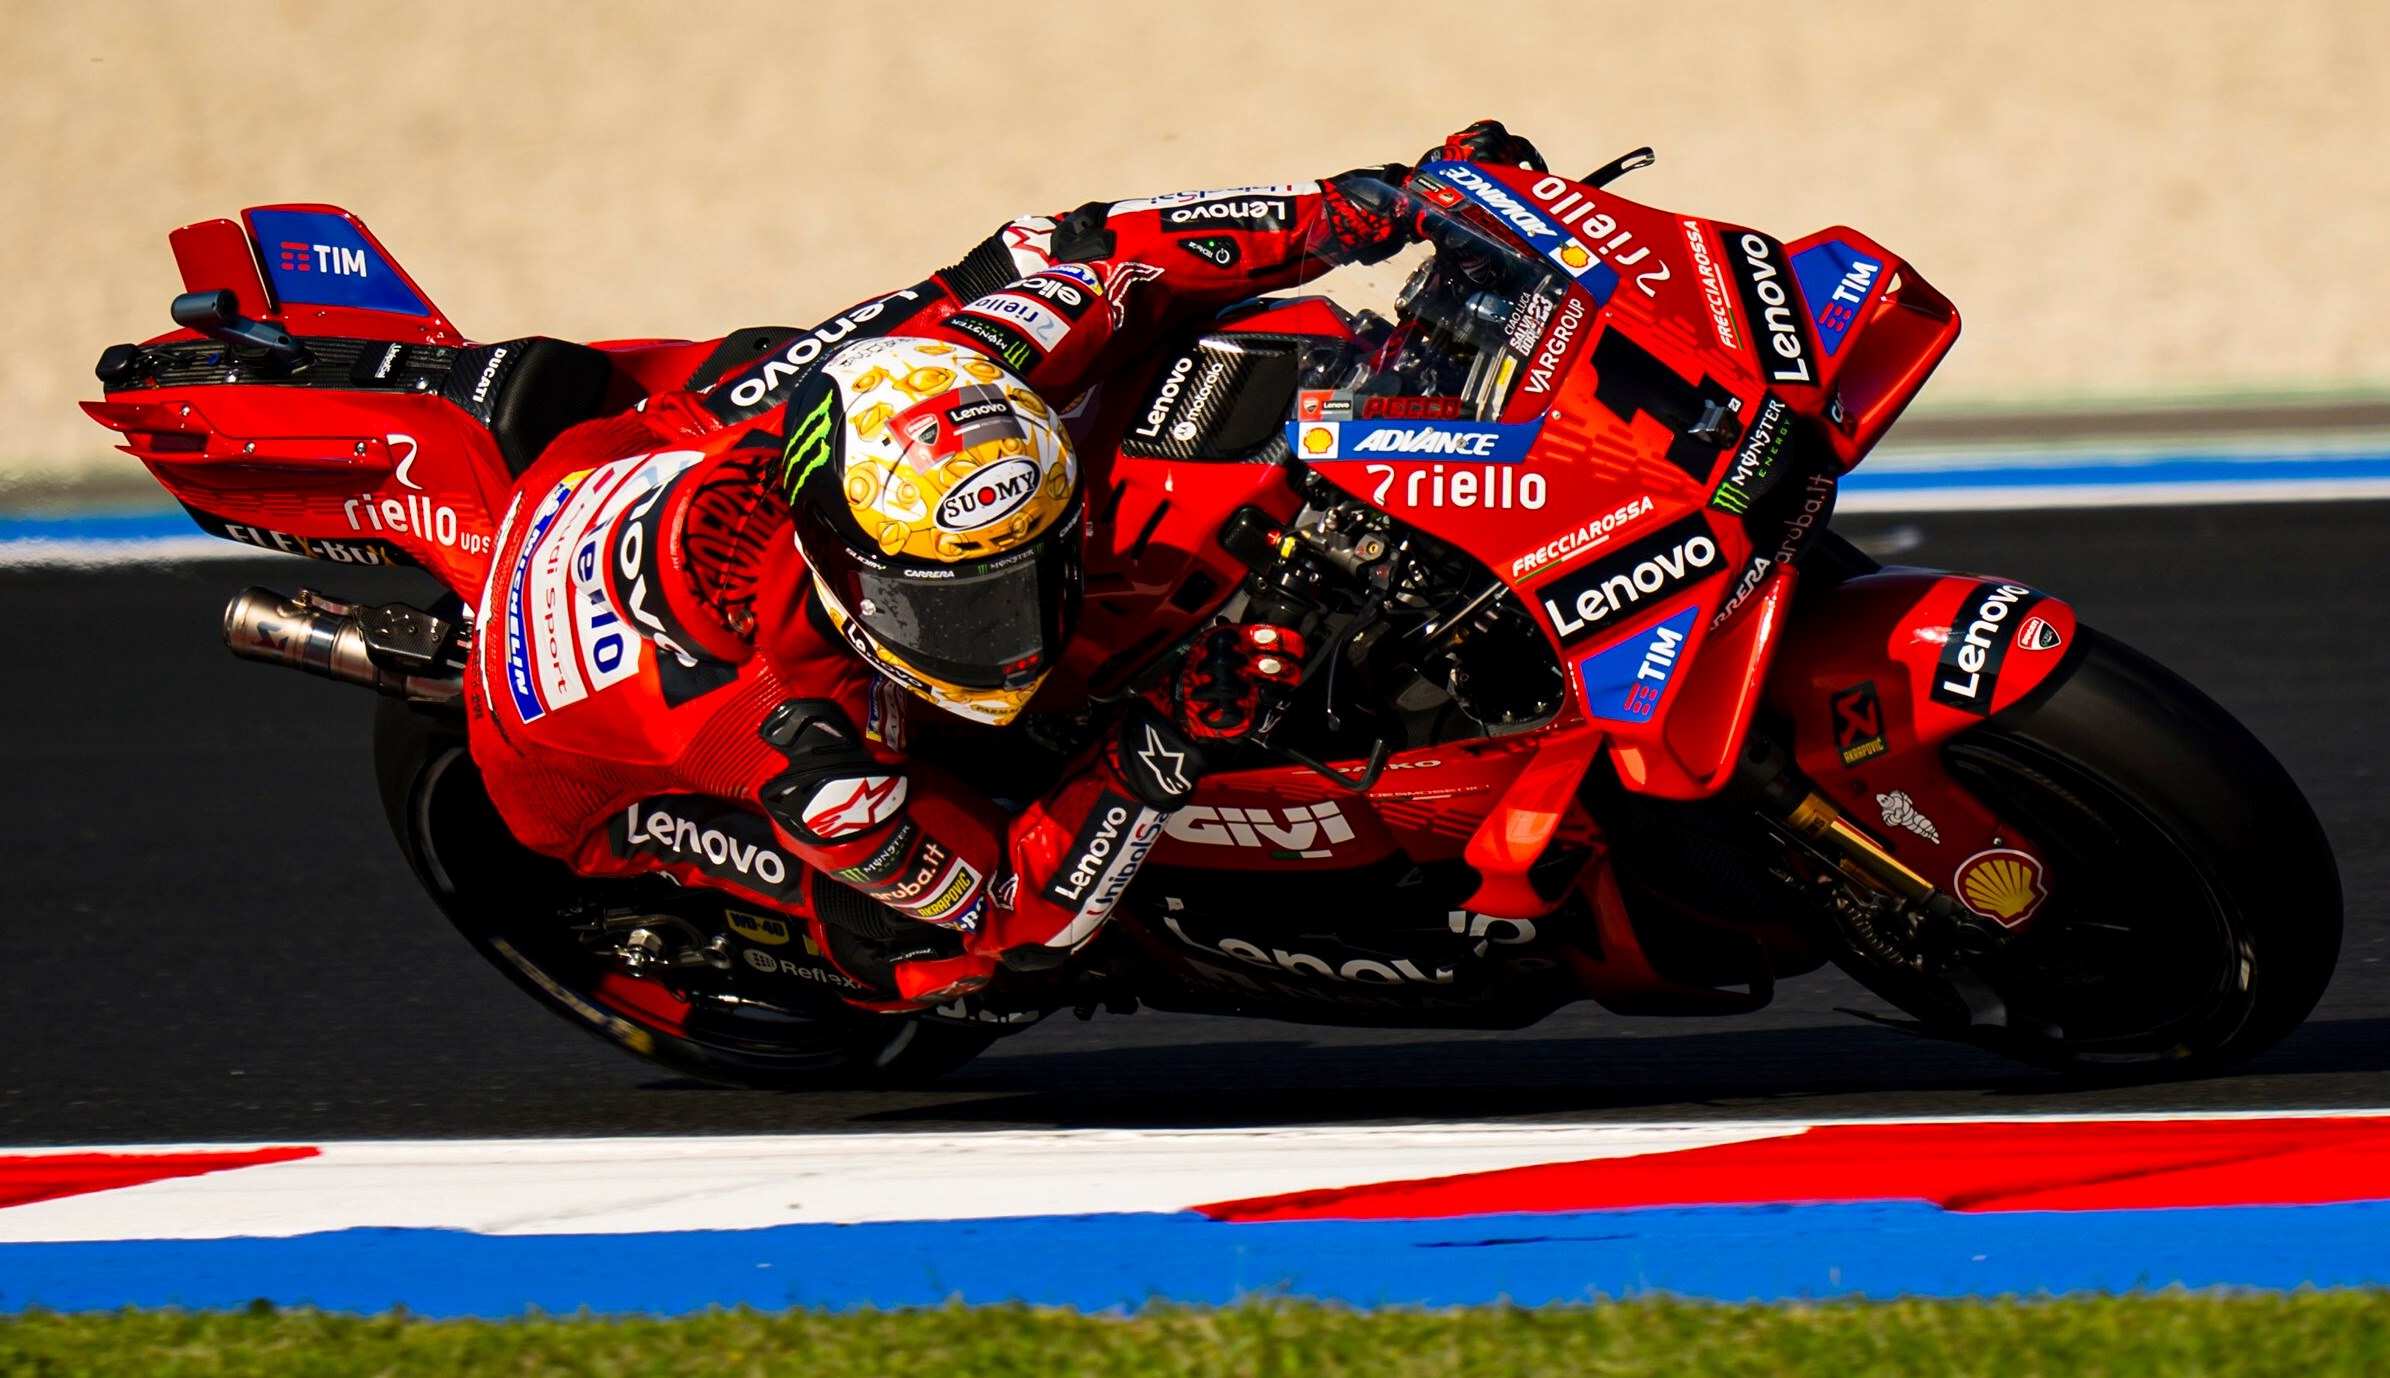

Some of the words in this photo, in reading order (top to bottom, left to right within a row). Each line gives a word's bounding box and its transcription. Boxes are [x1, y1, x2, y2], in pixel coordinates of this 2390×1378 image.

[1171, 200, 1287, 223] Lenovo
[1446, 166, 1558, 237] ADVANCE
[1532, 176, 1651, 267] riello
[313, 244, 368, 277] TIM
[1683, 220, 1737, 350] FRECCIAROSSA
[1832, 261, 1879, 304] TIM
[951, 318, 1008, 350] MONSTER
[975, 299, 1040, 324] riello
[1504, 312, 1521, 335] CIAO
[1516, 292, 1531, 314] LUCA
[1741, 233, 1811, 382] Lenovo
[472, 347, 508, 403] DUCATI
[730, 287, 919, 407] Lenovo
[1523, 298, 1585, 394] VARGROUP
[949, 402, 1008, 422] Lenovo
[1135, 357, 1193, 438] Lenovo
[1186, 362, 1224, 421] motorola
[1353, 428, 1499, 455] ADVANCE
[1731, 399, 1786, 487] MONSTER
[343, 493, 457, 547] riello
[460, 531, 491, 555] ups
[1407, 464, 1547, 510] riello
[1774, 474, 1835, 565] aruba.it
[903, 568, 955, 579] CARRERA
[1511, 495, 1655, 578] FRECCIAROSSA
[507, 527, 530, 697] MICHELIN
[1544, 535, 1716, 638] Lenovo
[545, 585, 568, 695] Sport
[1637, 626, 1684, 682] TIM
[1943, 584, 2030, 699] Lenovo
[626, 802, 786, 885] Lenovo
[1055, 805, 1128, 901] Lenovo
